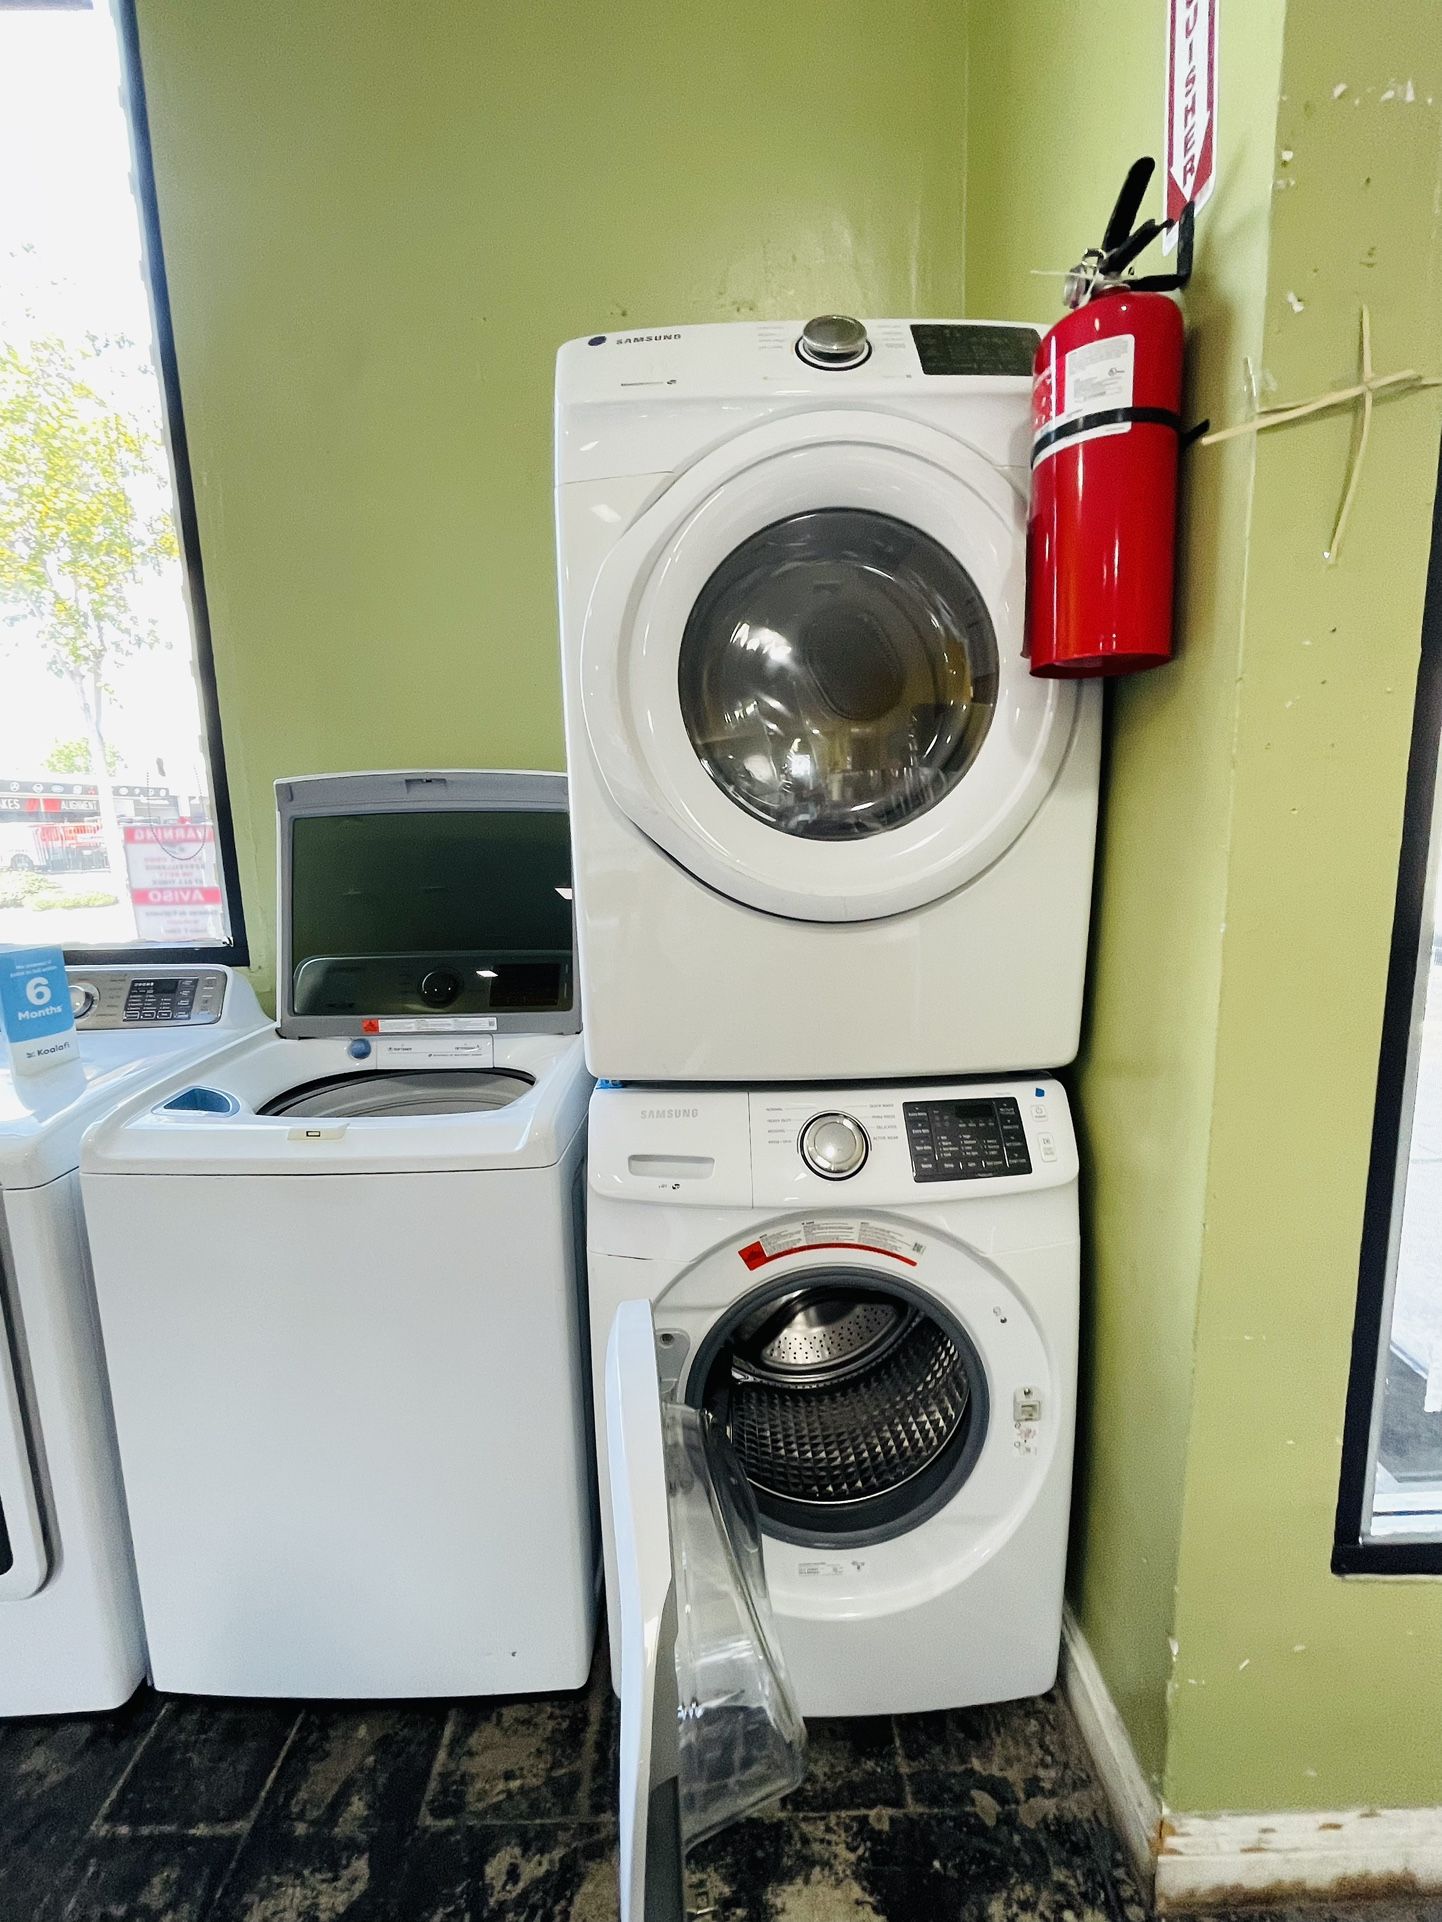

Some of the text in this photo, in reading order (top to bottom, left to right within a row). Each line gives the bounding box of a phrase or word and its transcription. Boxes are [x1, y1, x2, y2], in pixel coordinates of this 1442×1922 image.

[616, 333, 682, 345] SAMSUNG
[25, 976, 52, 1006] 6
[18, 1005, 63, 1021] Months
[37, 1042, 71, 1057] Koalafi
[640, 1108, 699, 1120] SAMSUNG
